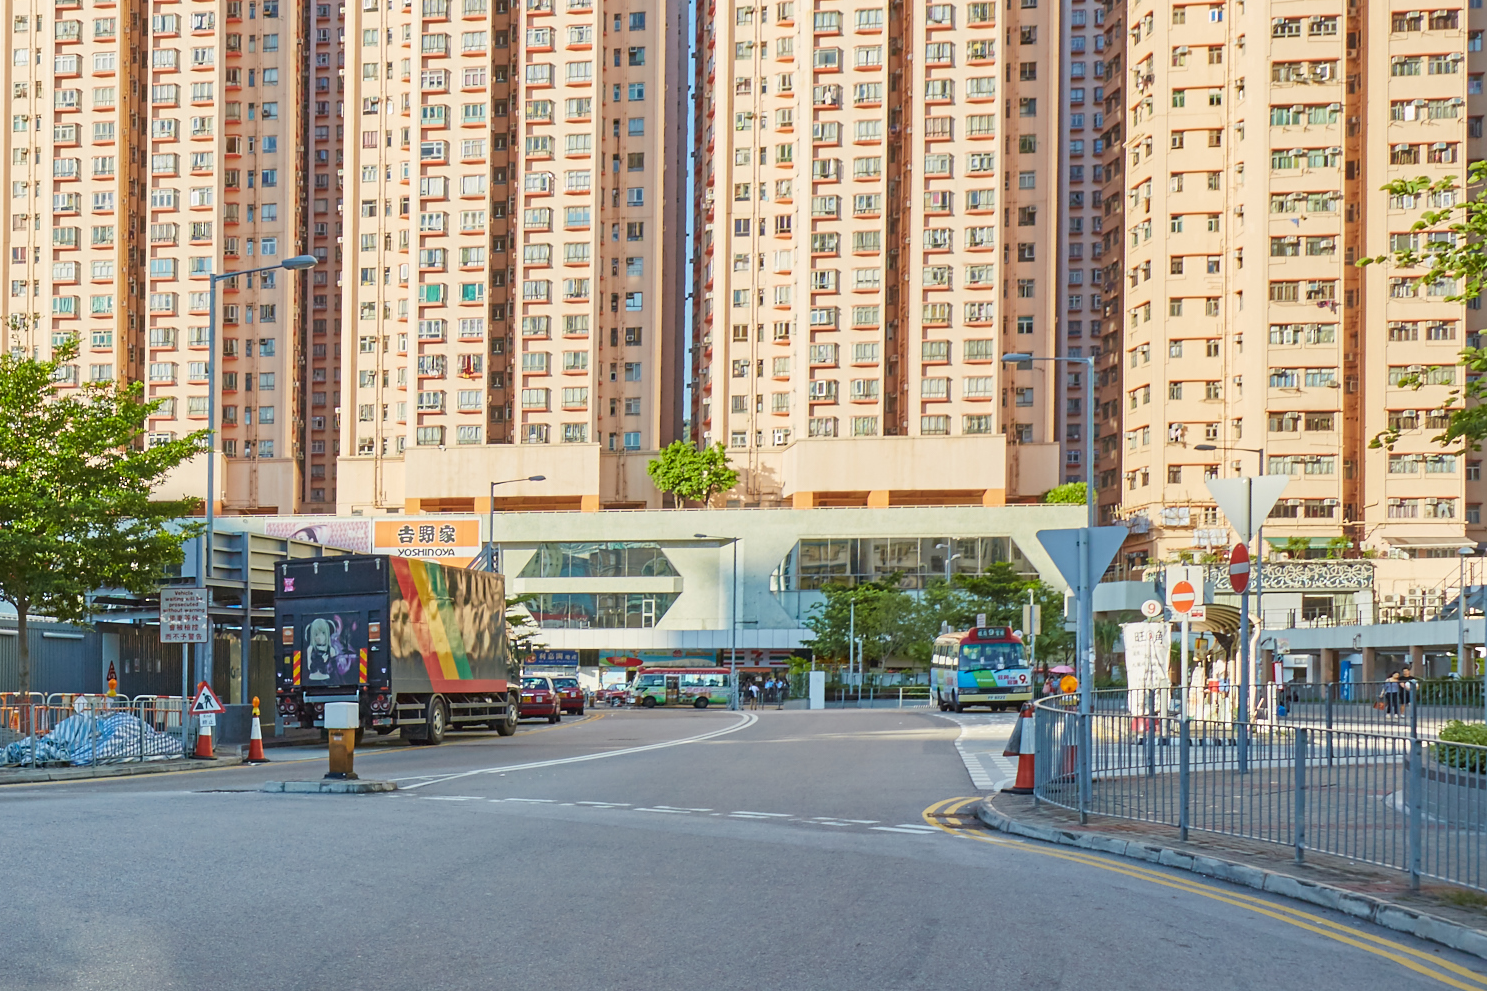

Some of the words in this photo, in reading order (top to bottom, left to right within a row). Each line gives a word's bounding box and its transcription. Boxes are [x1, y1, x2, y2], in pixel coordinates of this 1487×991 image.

[397, 548, 455, 557] YOSHINOYA
[1148, 603, 1156, 614] 9
[1019, 673, 1026, 684] 9
